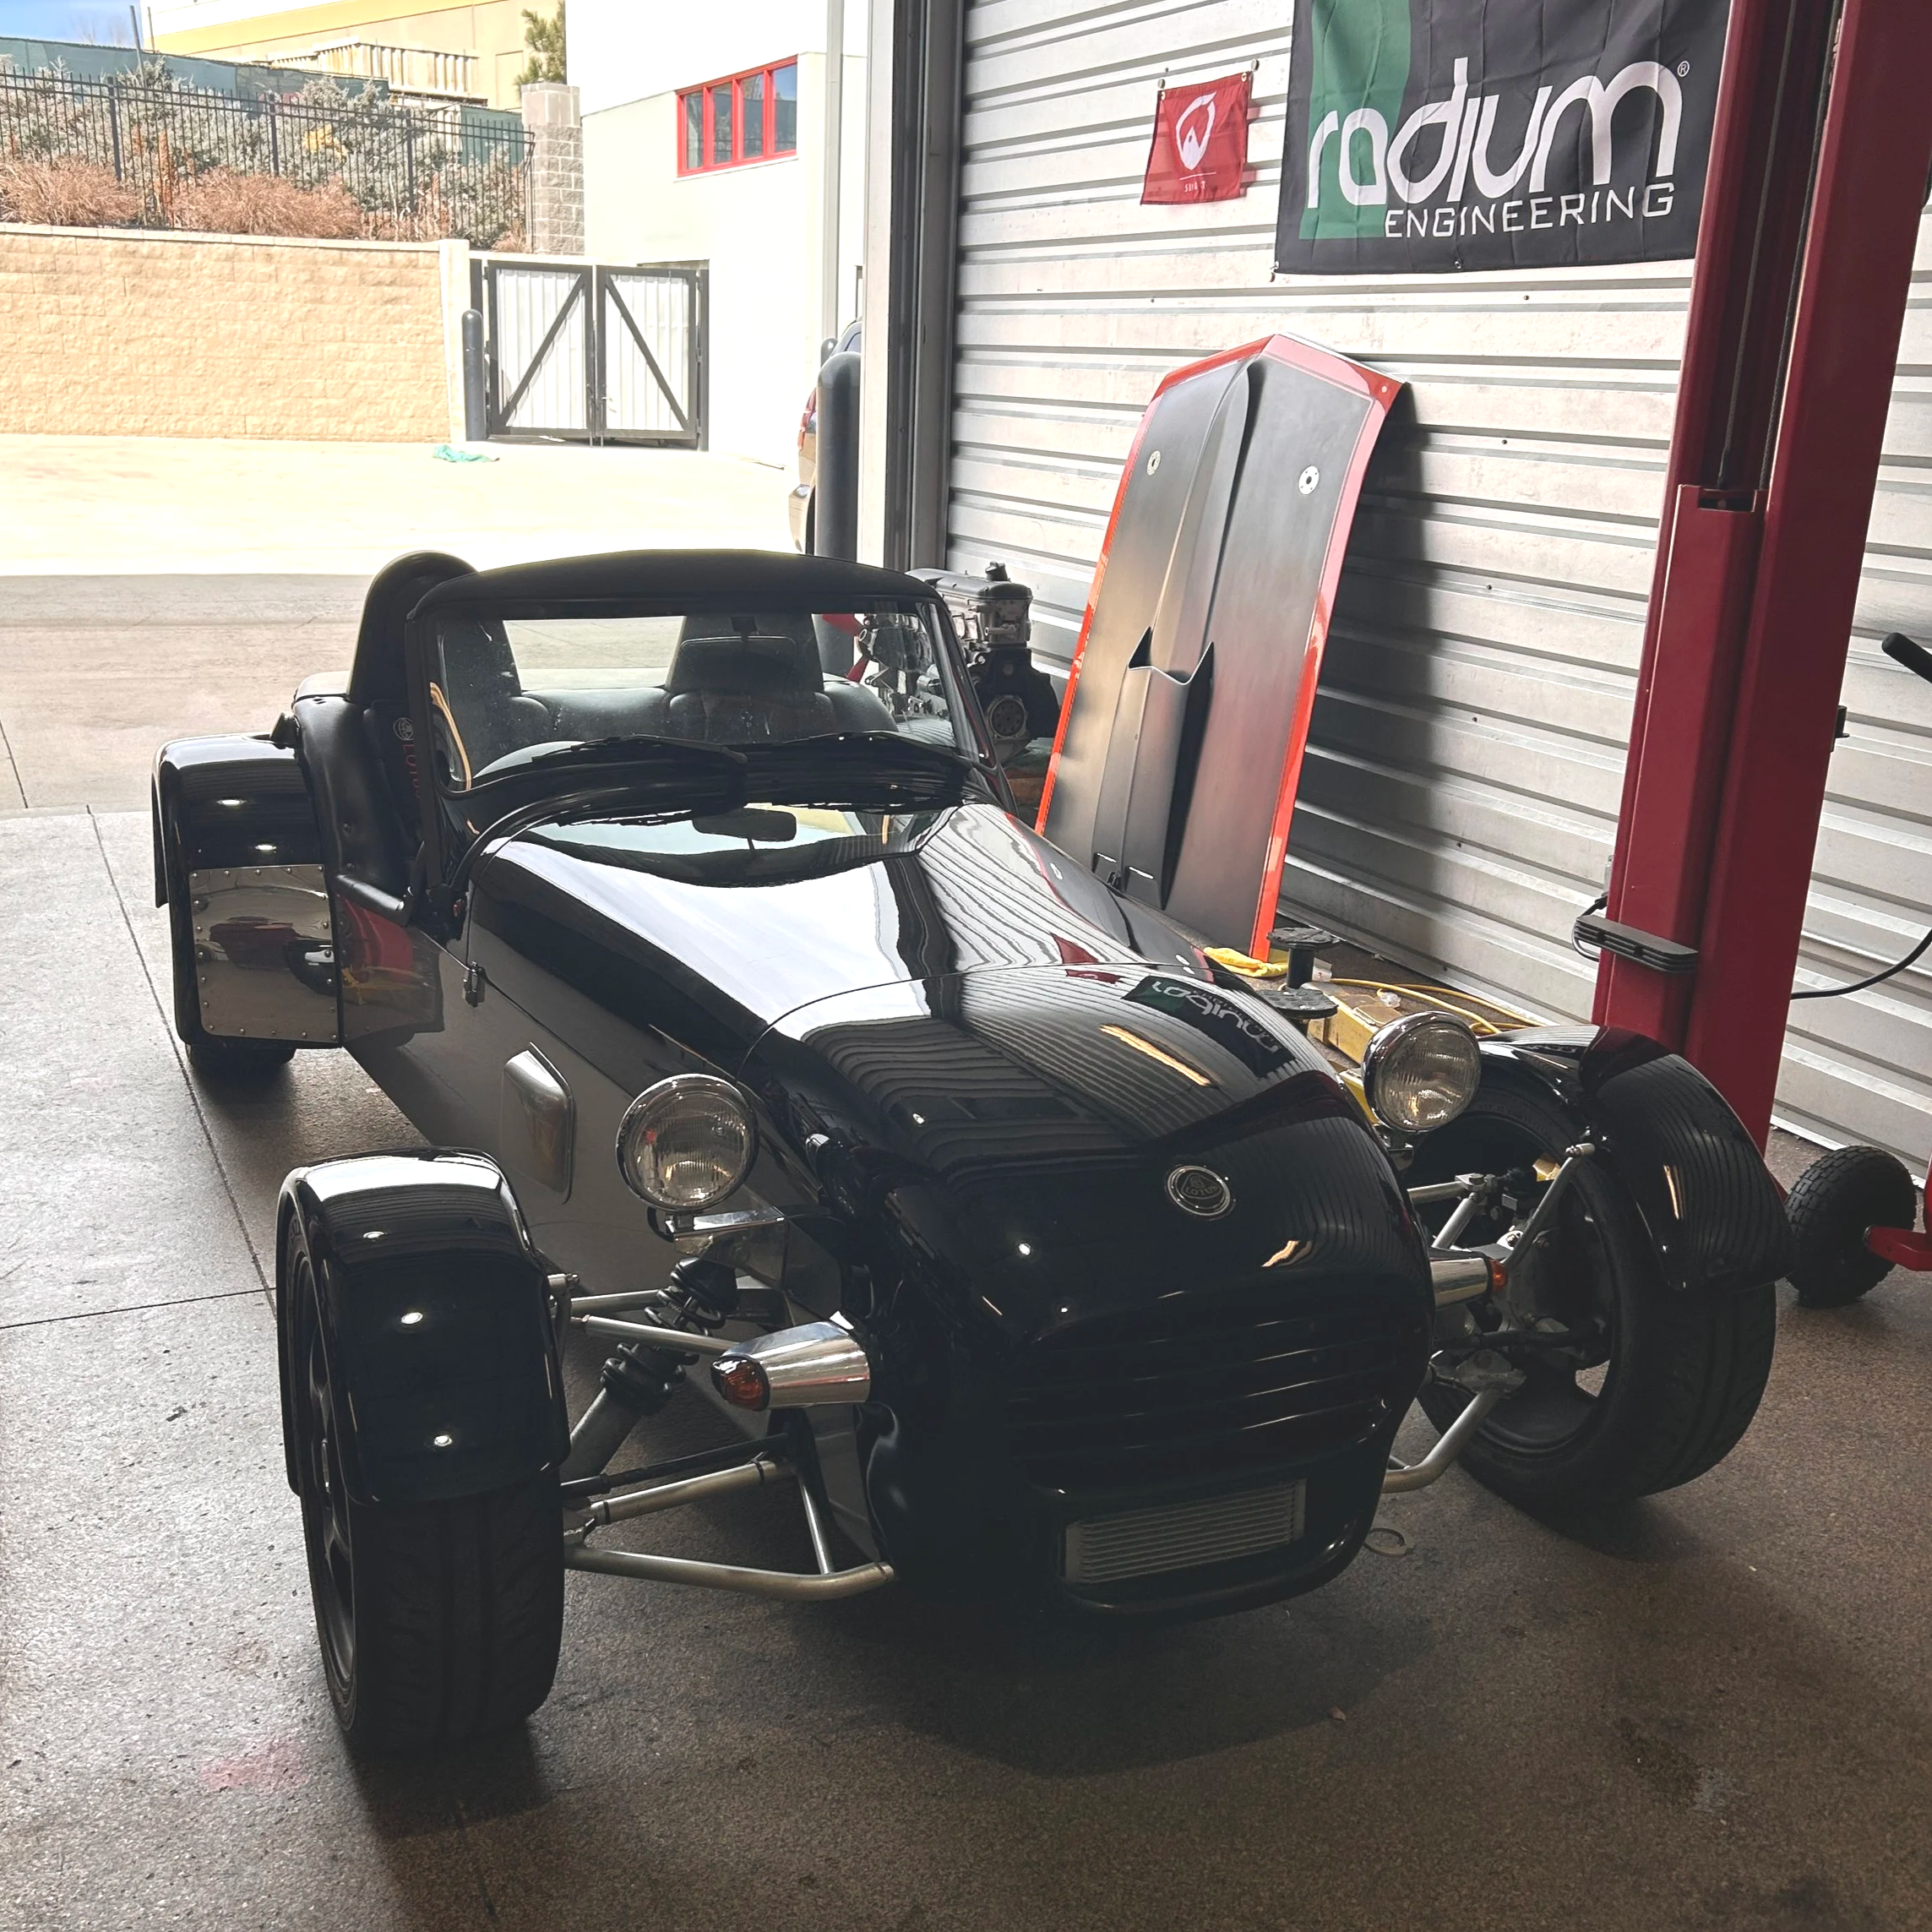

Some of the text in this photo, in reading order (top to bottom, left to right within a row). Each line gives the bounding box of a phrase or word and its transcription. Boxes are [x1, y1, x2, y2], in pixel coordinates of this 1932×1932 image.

[1307, 57, 1684, 210] radium
[1384, 182, 1674, 238] ENGINEERING
[1184, 1184, 1218, 1195] LOTUS
